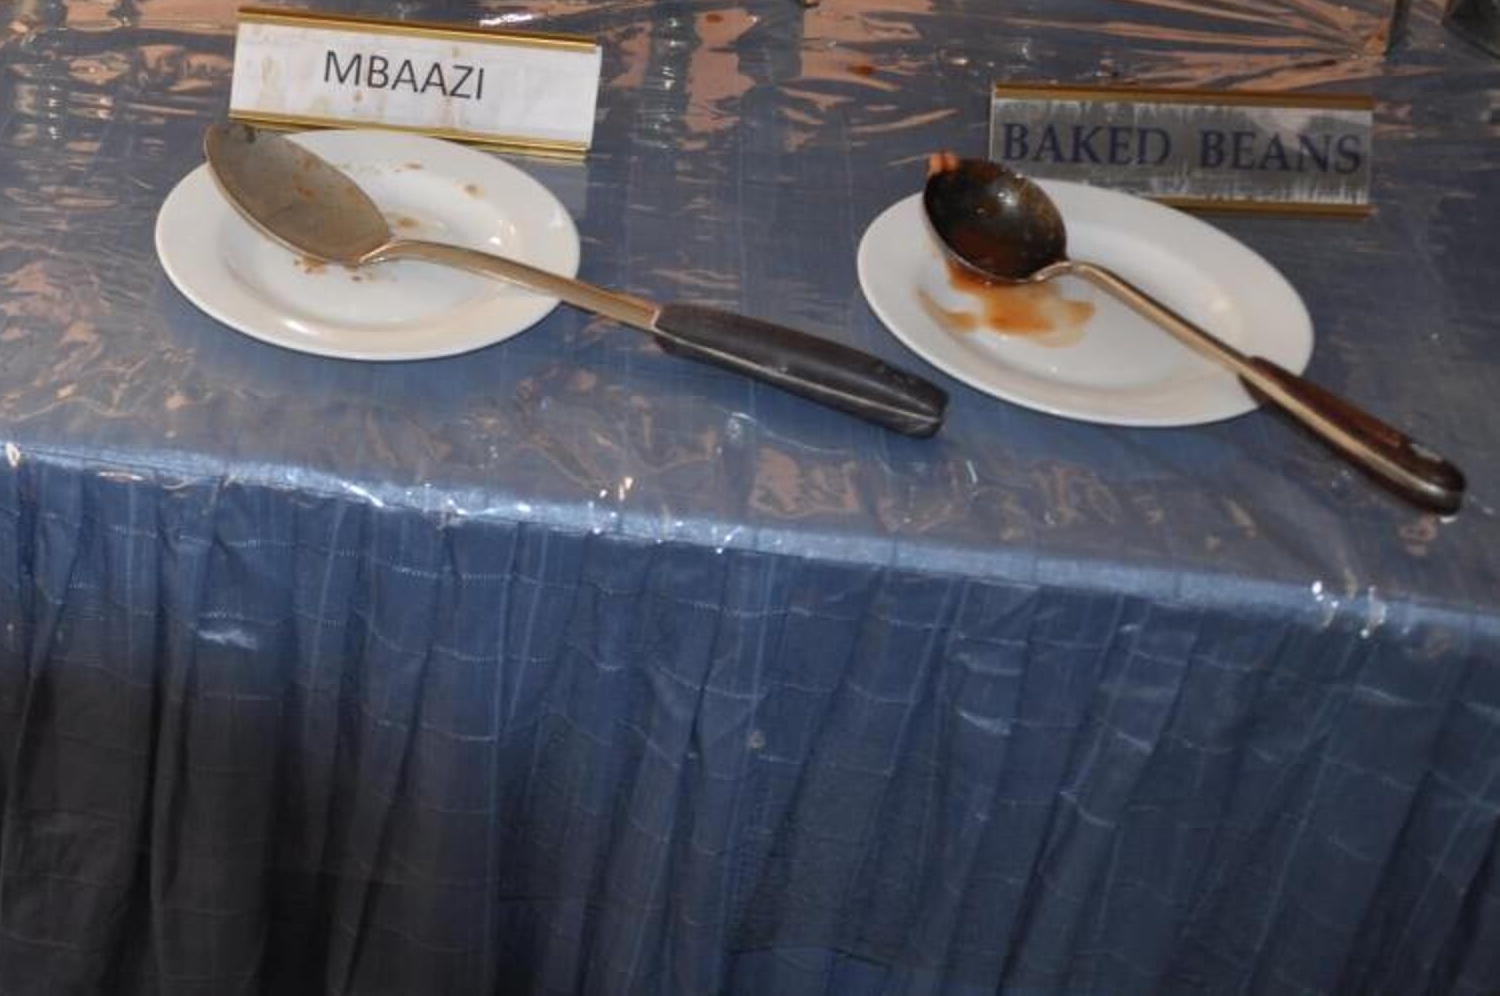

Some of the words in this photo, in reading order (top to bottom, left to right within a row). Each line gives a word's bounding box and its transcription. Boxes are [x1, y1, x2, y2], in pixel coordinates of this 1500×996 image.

[323, 50, 485, 100] MBAAZI
[1002, 122, 1172, 165] BAKED
[1199, 129, 1362, 174] BEANS
